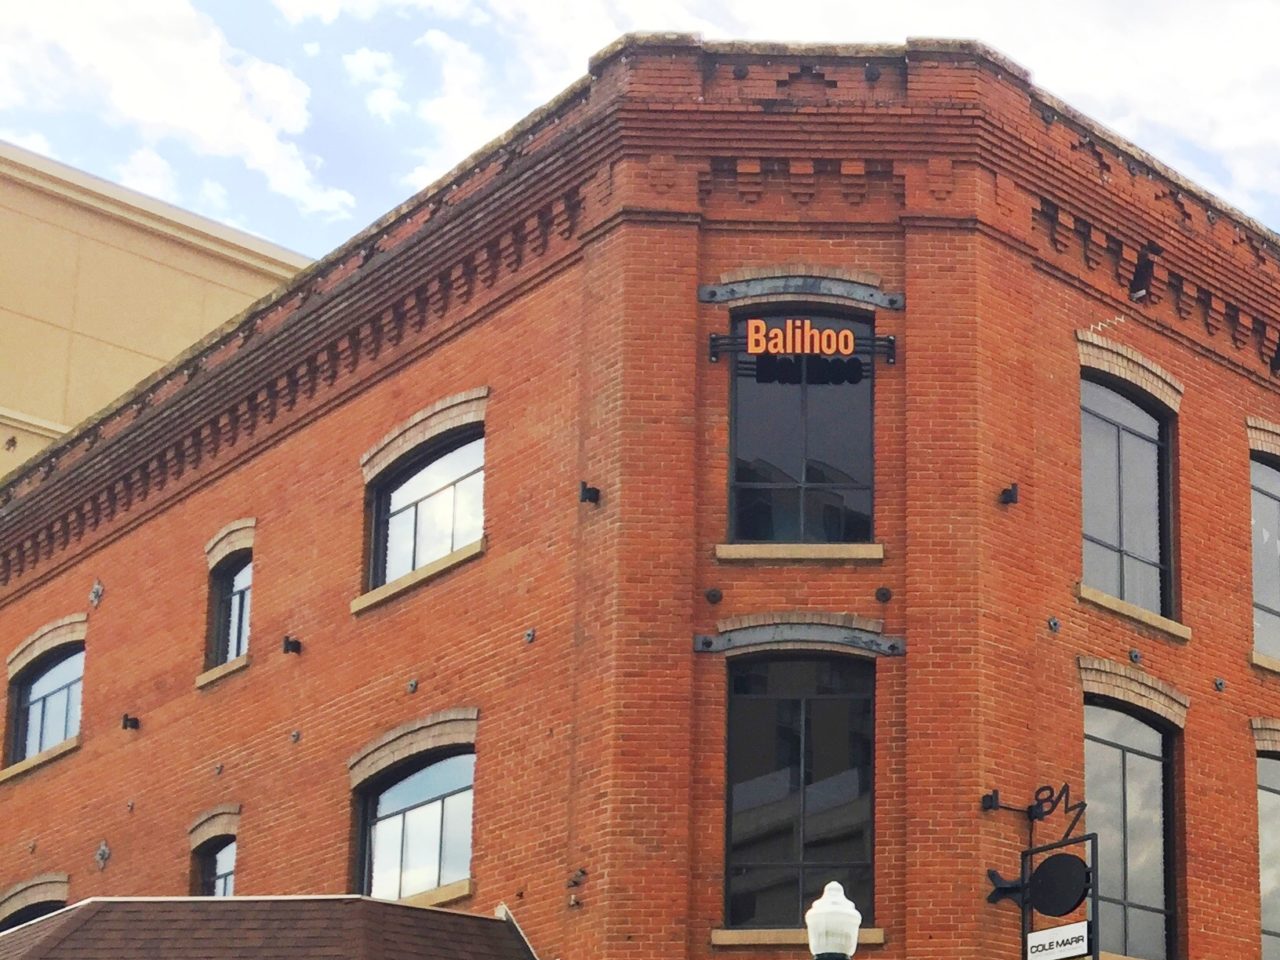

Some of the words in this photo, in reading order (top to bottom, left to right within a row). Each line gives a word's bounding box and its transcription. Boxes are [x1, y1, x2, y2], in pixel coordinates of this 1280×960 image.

[747, 319, 855, 355] Balihoo
[1030, 941, 1055, 954] COLE
[1056, 935, 1085, 948] MARR
